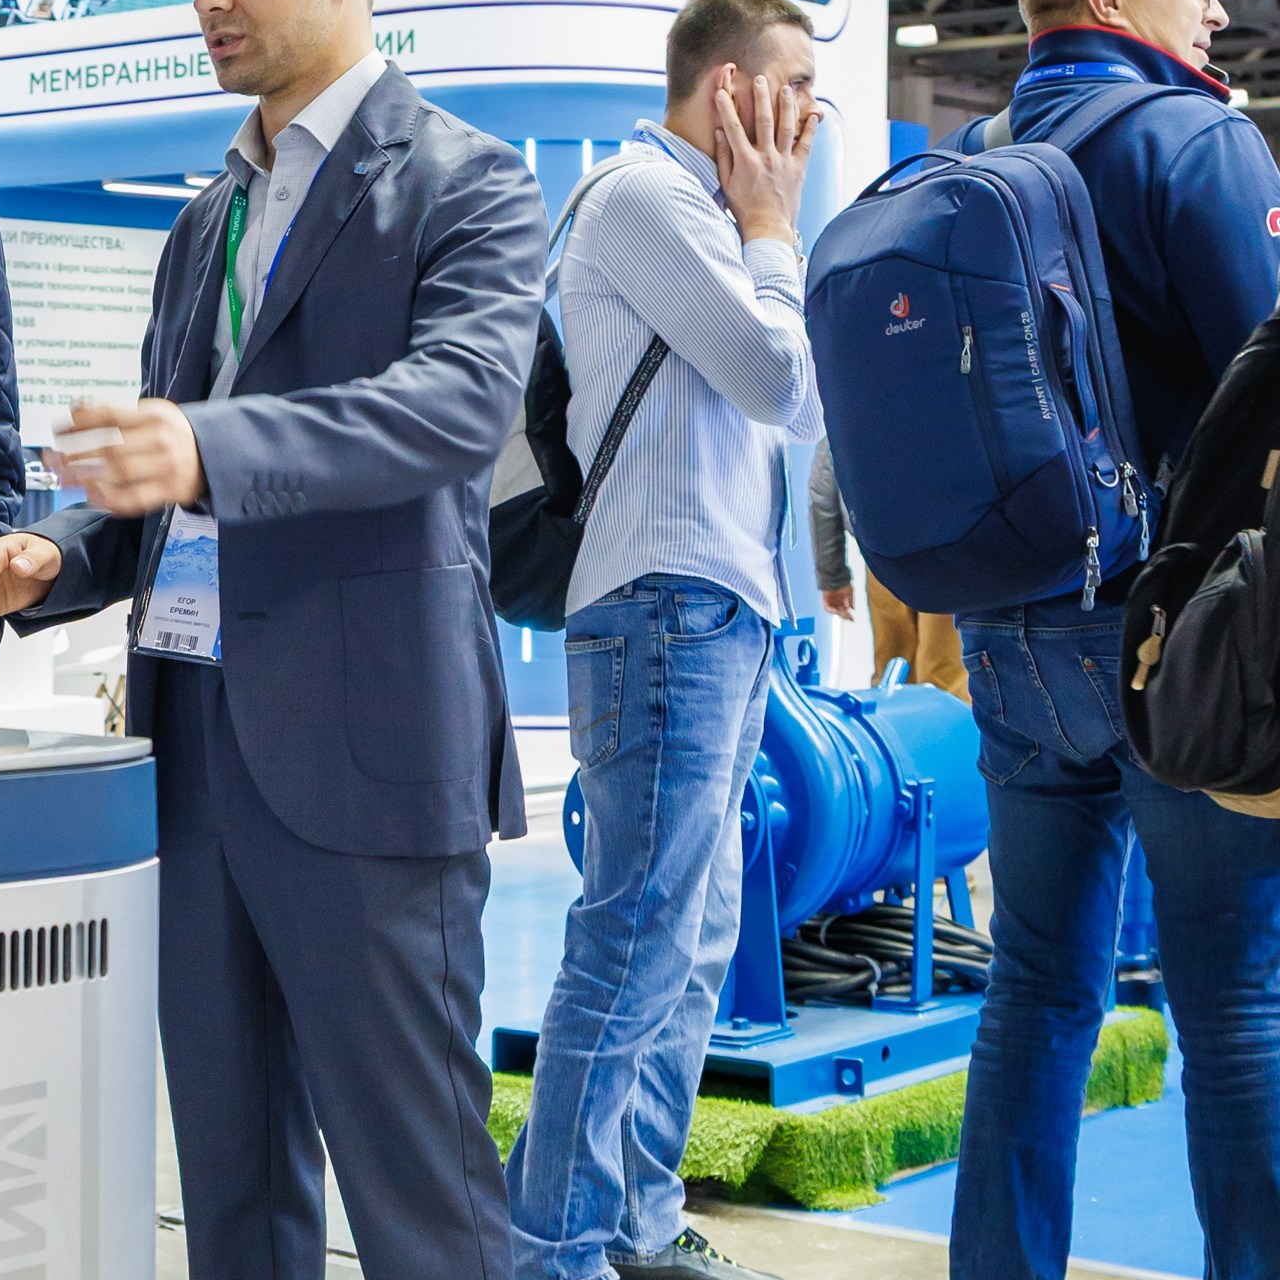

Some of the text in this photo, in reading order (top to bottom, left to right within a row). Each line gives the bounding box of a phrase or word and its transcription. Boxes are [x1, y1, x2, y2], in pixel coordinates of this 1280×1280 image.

[28, 54, 209, 96] МЕМБРАННЫЕ
[21, 231, 124, 250] ПРЕИМУЩЕСТВА:
[885, 318, 926, 336] deuter
[1021, 311, 1031, 325] 28
[1024, 326, 1034, 341] ON
[1027, 343, 1040, 376] CARRY
[1035, 386, 1052, 420] AVIANT
[177, 596, 196, 605] ЕГОР
[169, 607, 199, 616] ЕРЕМИН
